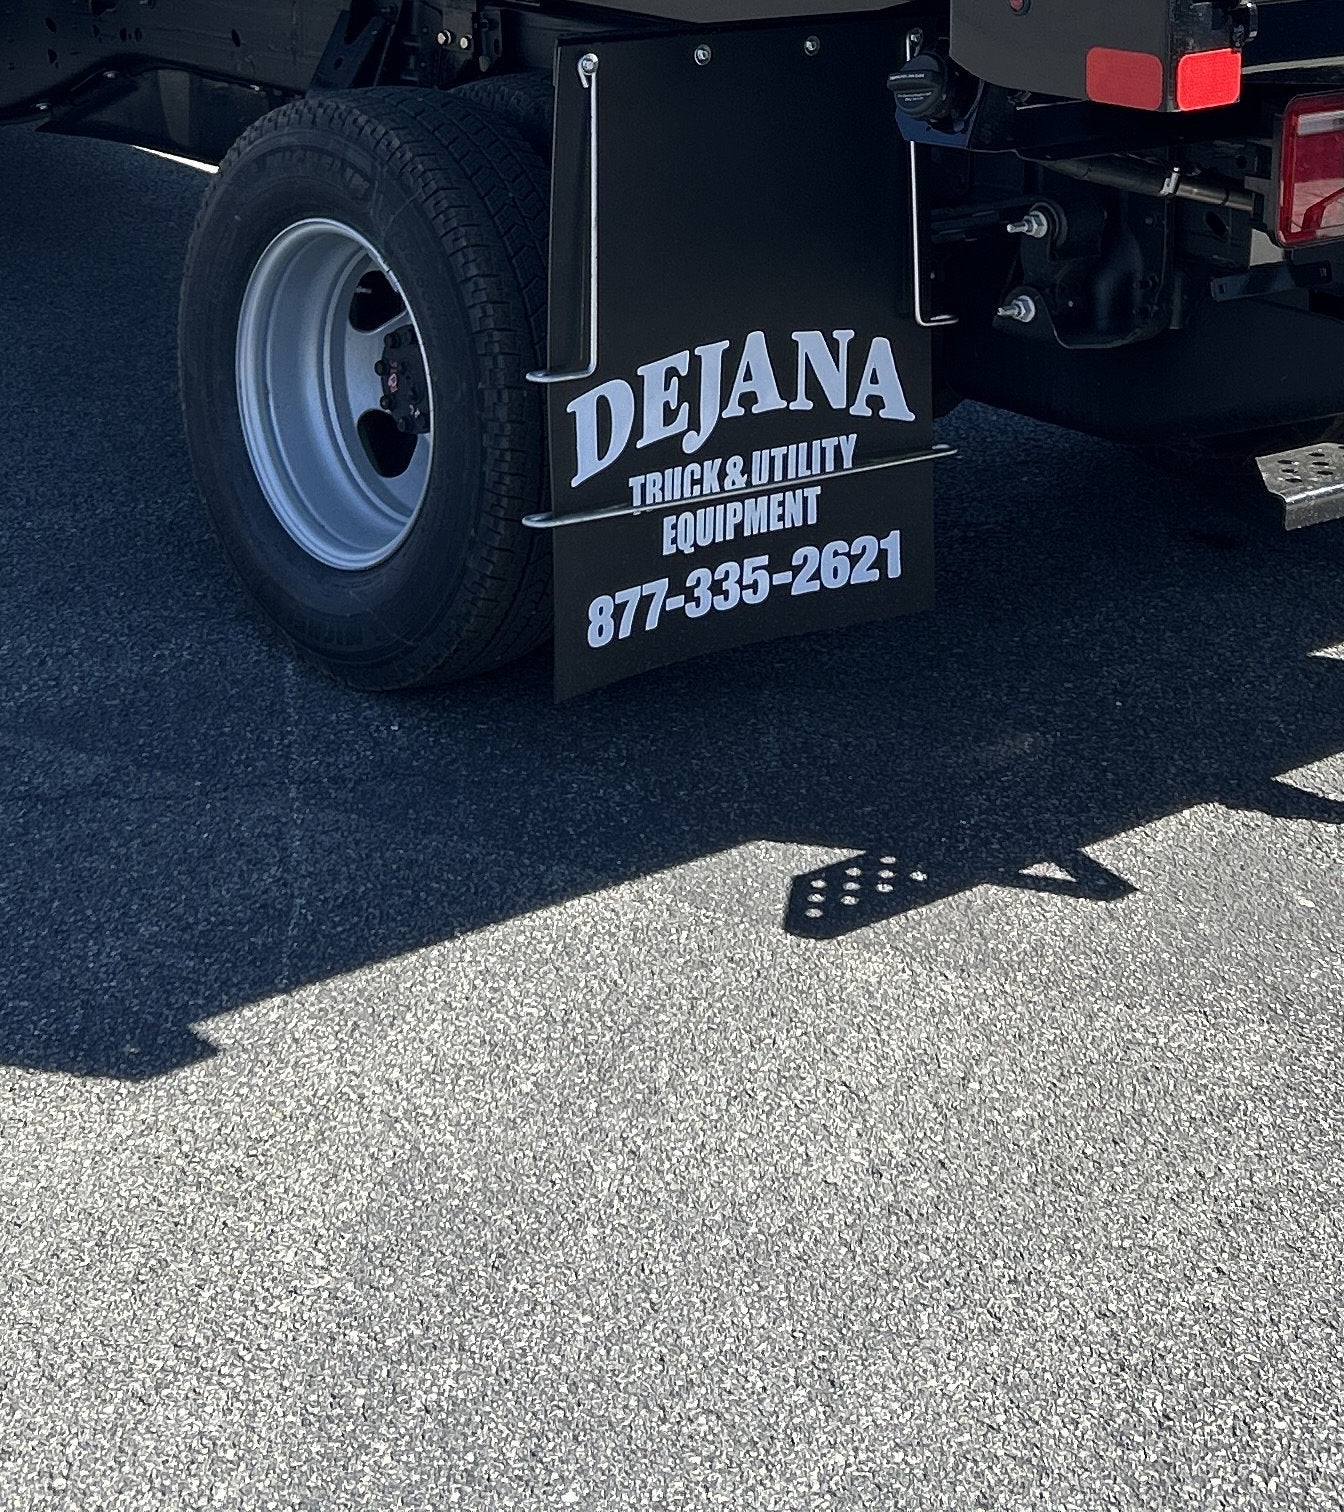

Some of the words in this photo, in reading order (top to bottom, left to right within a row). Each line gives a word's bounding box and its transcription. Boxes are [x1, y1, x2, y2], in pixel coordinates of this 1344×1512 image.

[566, 329, 916, 487] DEJANA
[661, 486, 821, 556] EQUIPMENT
[586, 529, 902, 648] 877-335-2621
